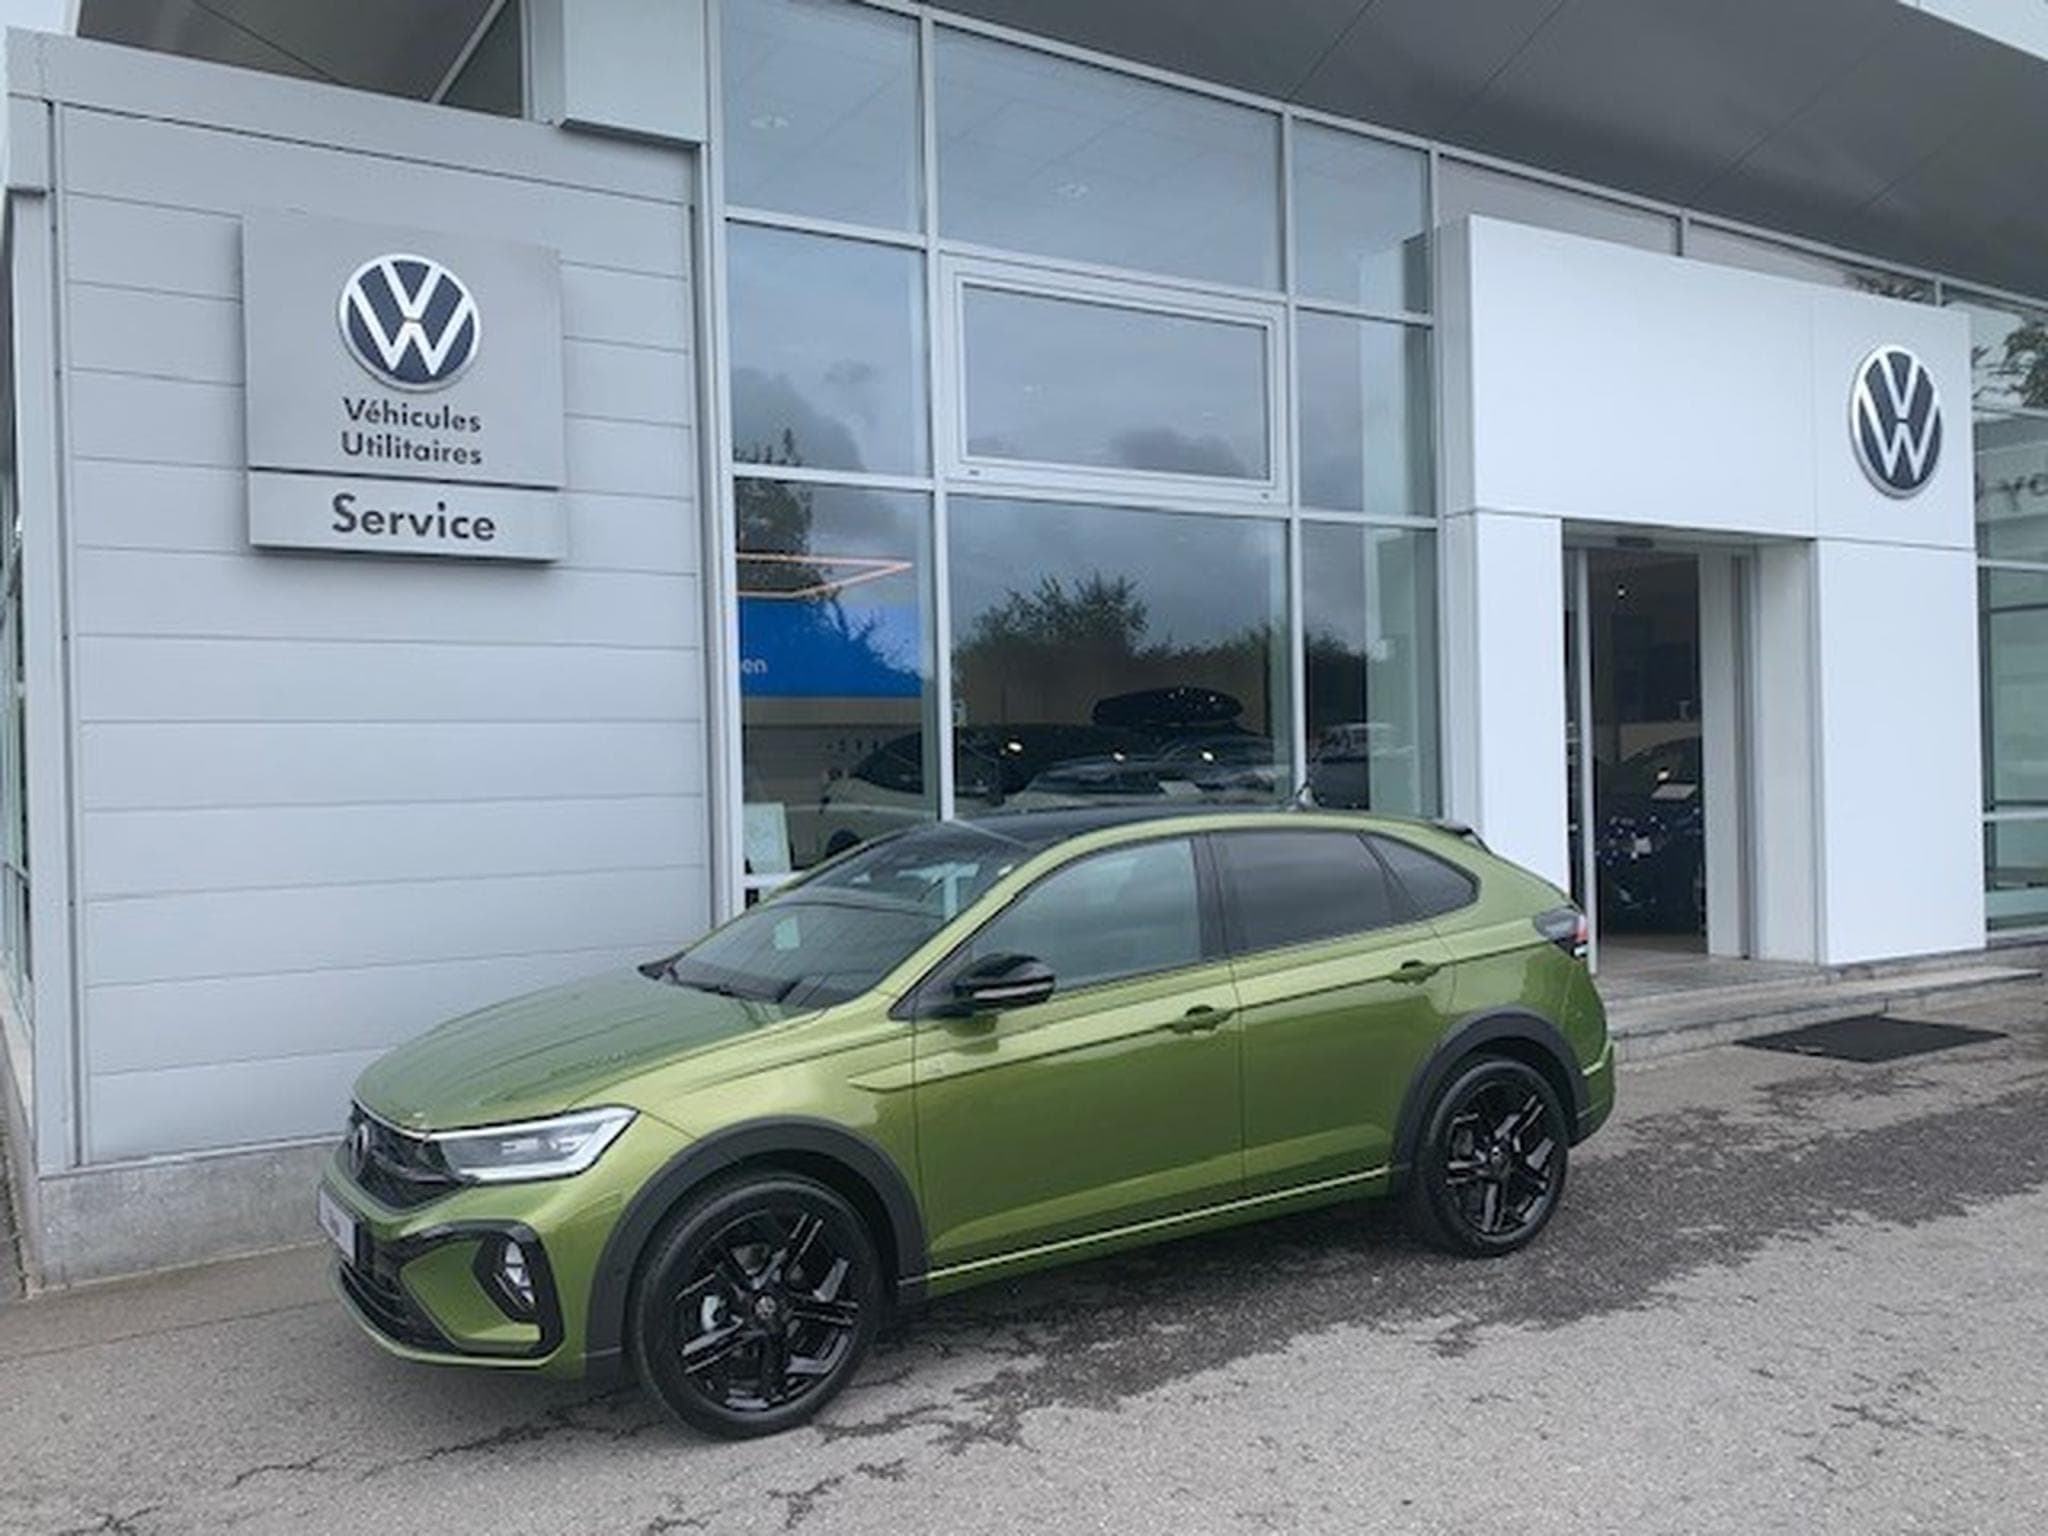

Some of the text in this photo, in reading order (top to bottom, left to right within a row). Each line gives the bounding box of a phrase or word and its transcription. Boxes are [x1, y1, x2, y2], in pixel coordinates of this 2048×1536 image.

[342, 397, 482, 432] Véhicules
[341, 431, 483, 465] Utilitaires
[332, 493, 496, 541] Service
